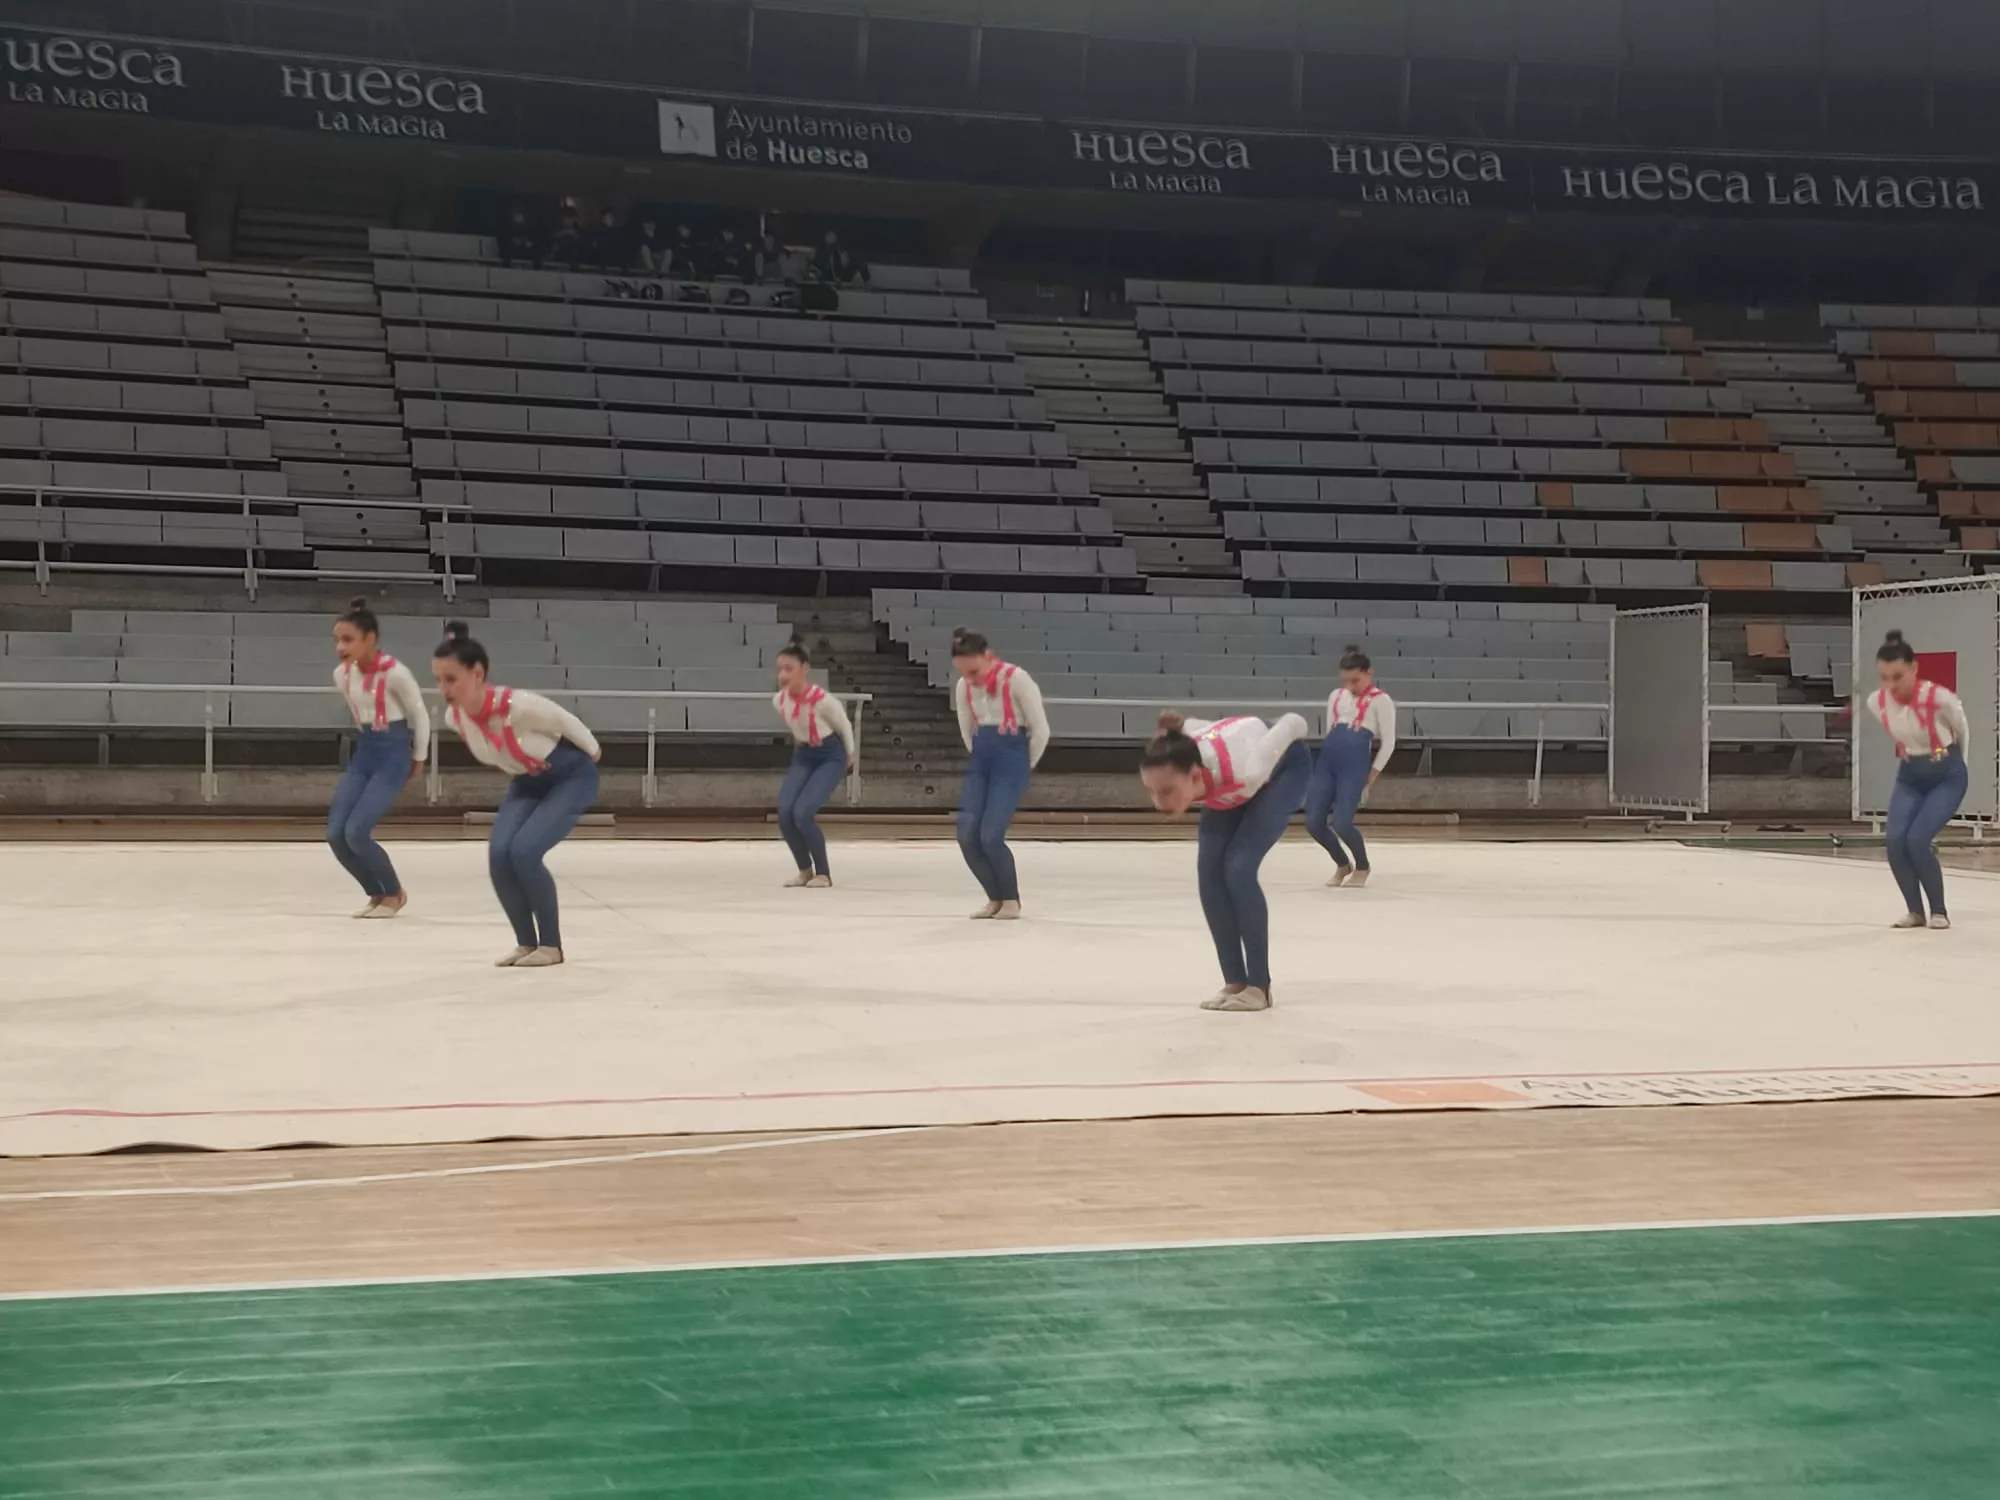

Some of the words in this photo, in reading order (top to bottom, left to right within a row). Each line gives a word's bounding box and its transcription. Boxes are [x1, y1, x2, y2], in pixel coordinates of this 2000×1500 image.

[0, 37, 187, 87] uesca
[281, 65, 488, 114] Huesca
[726, 107, 913, 144] Ayuntamiento
[726, 138, 758, 161] de
[767, 139, 869, 169] Huesca
[1071, 129, 1252, 169] Huesca
[1328, 141, 1507, 182] Huesca
[1562, 162, 1755, 205] Huesca
[1646, 1085, 1911, 1099] Huesca
